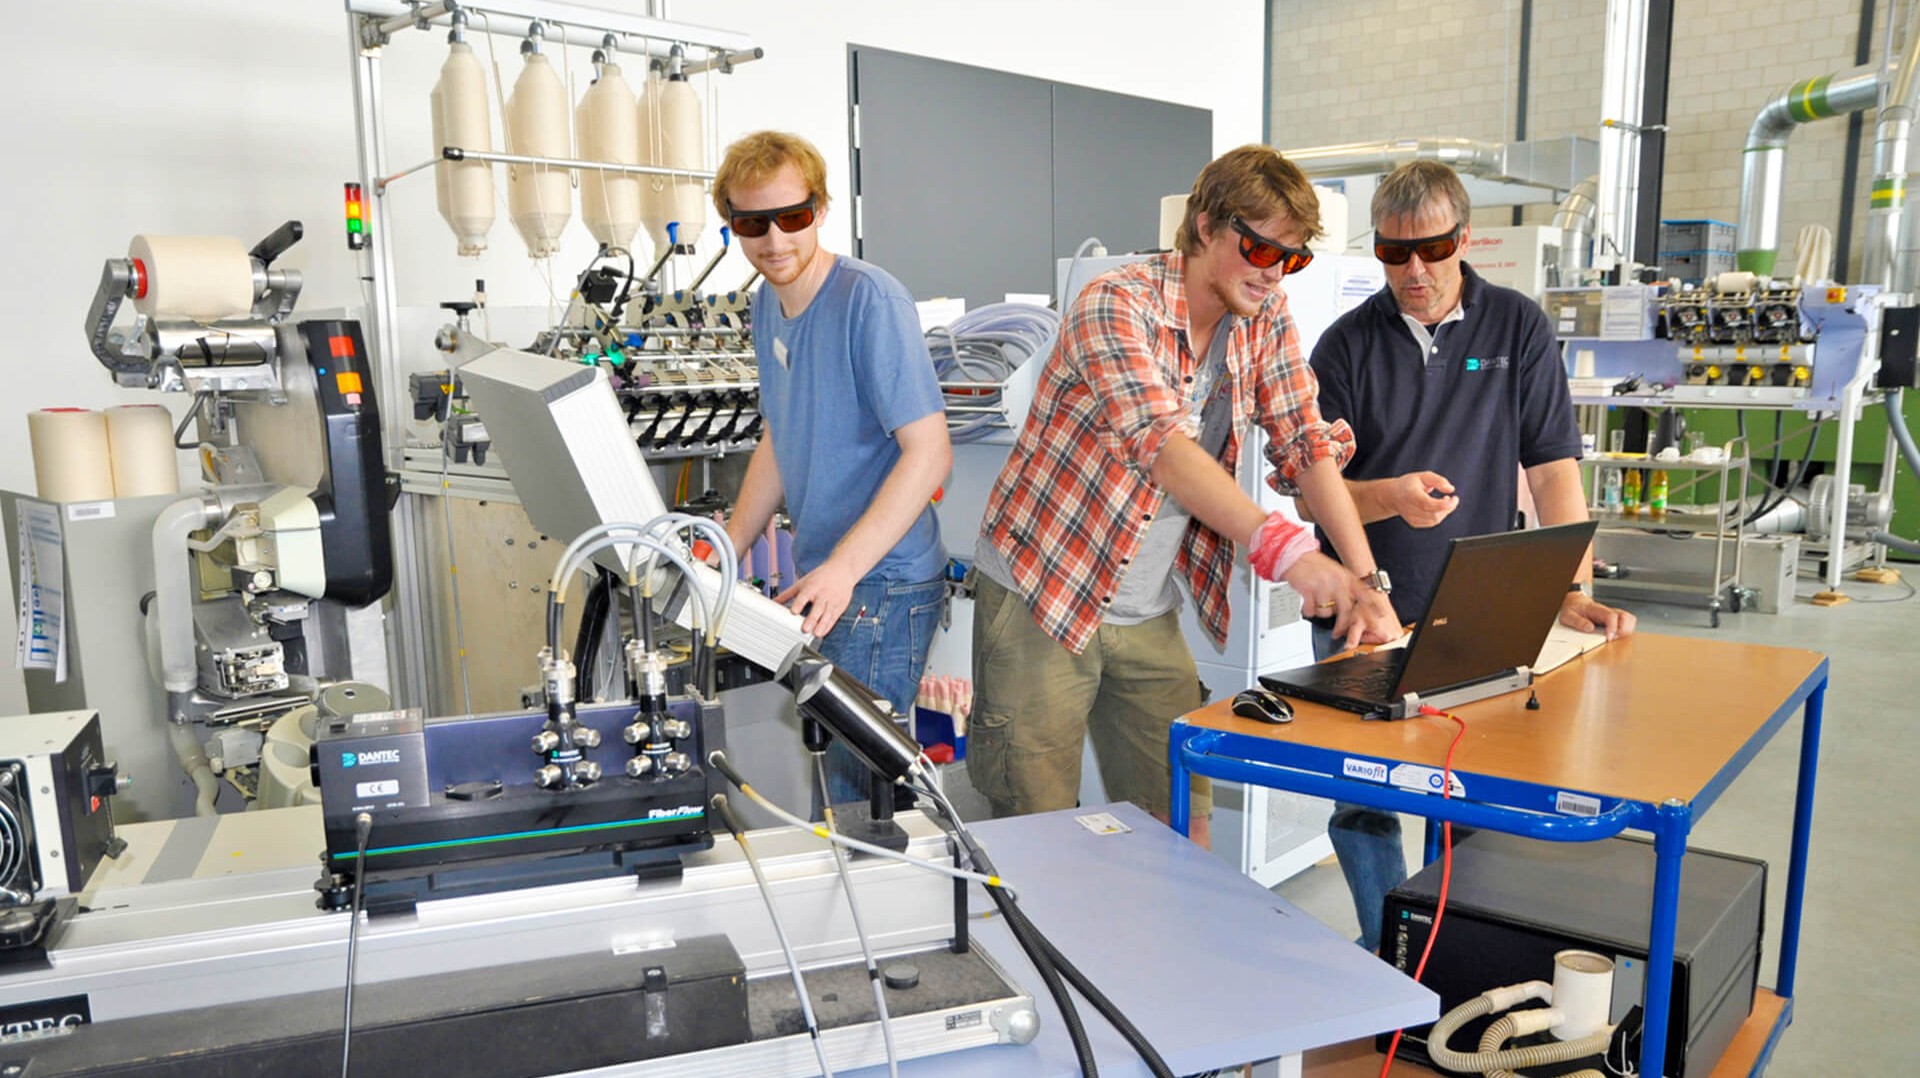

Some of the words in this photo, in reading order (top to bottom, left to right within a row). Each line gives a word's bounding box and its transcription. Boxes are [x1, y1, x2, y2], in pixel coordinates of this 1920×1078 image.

[358, 749, 400, 762] DANTEC
[1345, 763, 1385, 779] VARIOfit
[0, 1014, 83, 1036] TEC
